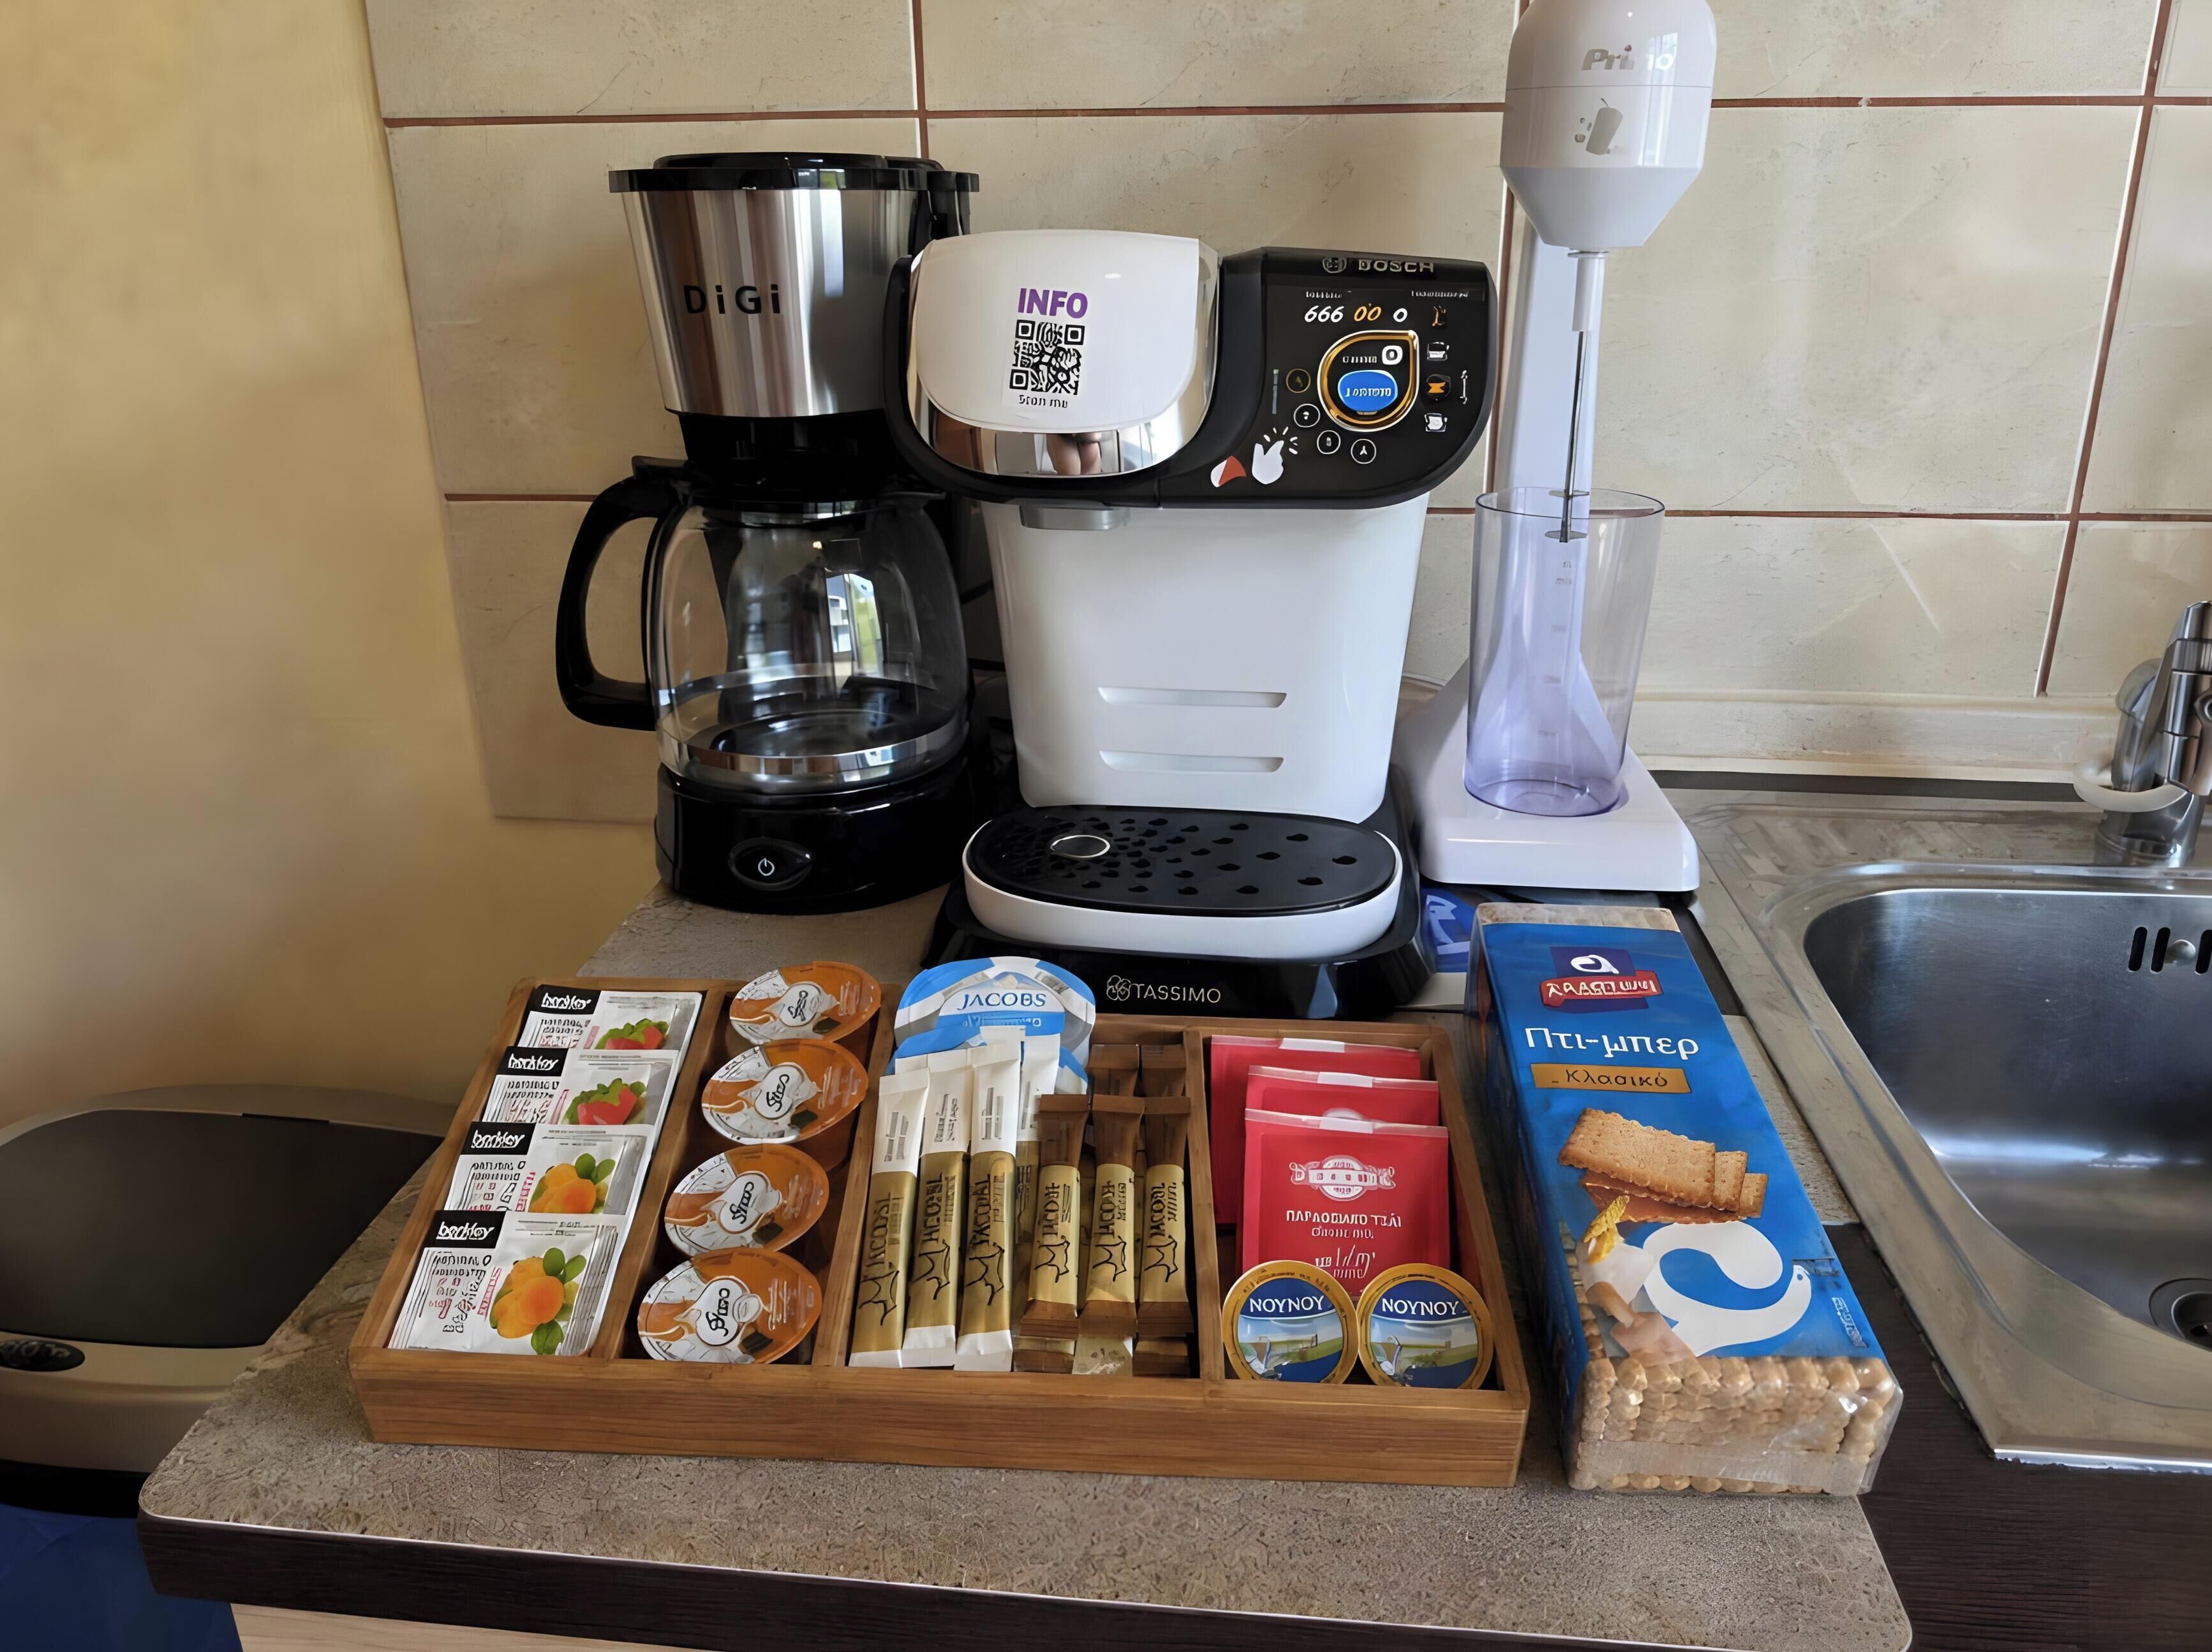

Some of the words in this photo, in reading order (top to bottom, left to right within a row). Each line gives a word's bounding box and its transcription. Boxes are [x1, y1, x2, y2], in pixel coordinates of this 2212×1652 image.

[683, 284, 782, 314] DiGi
[1018, 288, 1088, 319] INFO
[956, 992, 1046, 1010] JACOBS
[1134, 983, 1221, 1003] TASSIMO
[1524, 1027, 1700, 1060] Πτι-μπερ
[1565, 1068, 1668, 1088] Κλασικό
[1248, 1295, 1325, 1313] NOYNOY
[1381, 1297, 1460, 1316] NOYNOY
